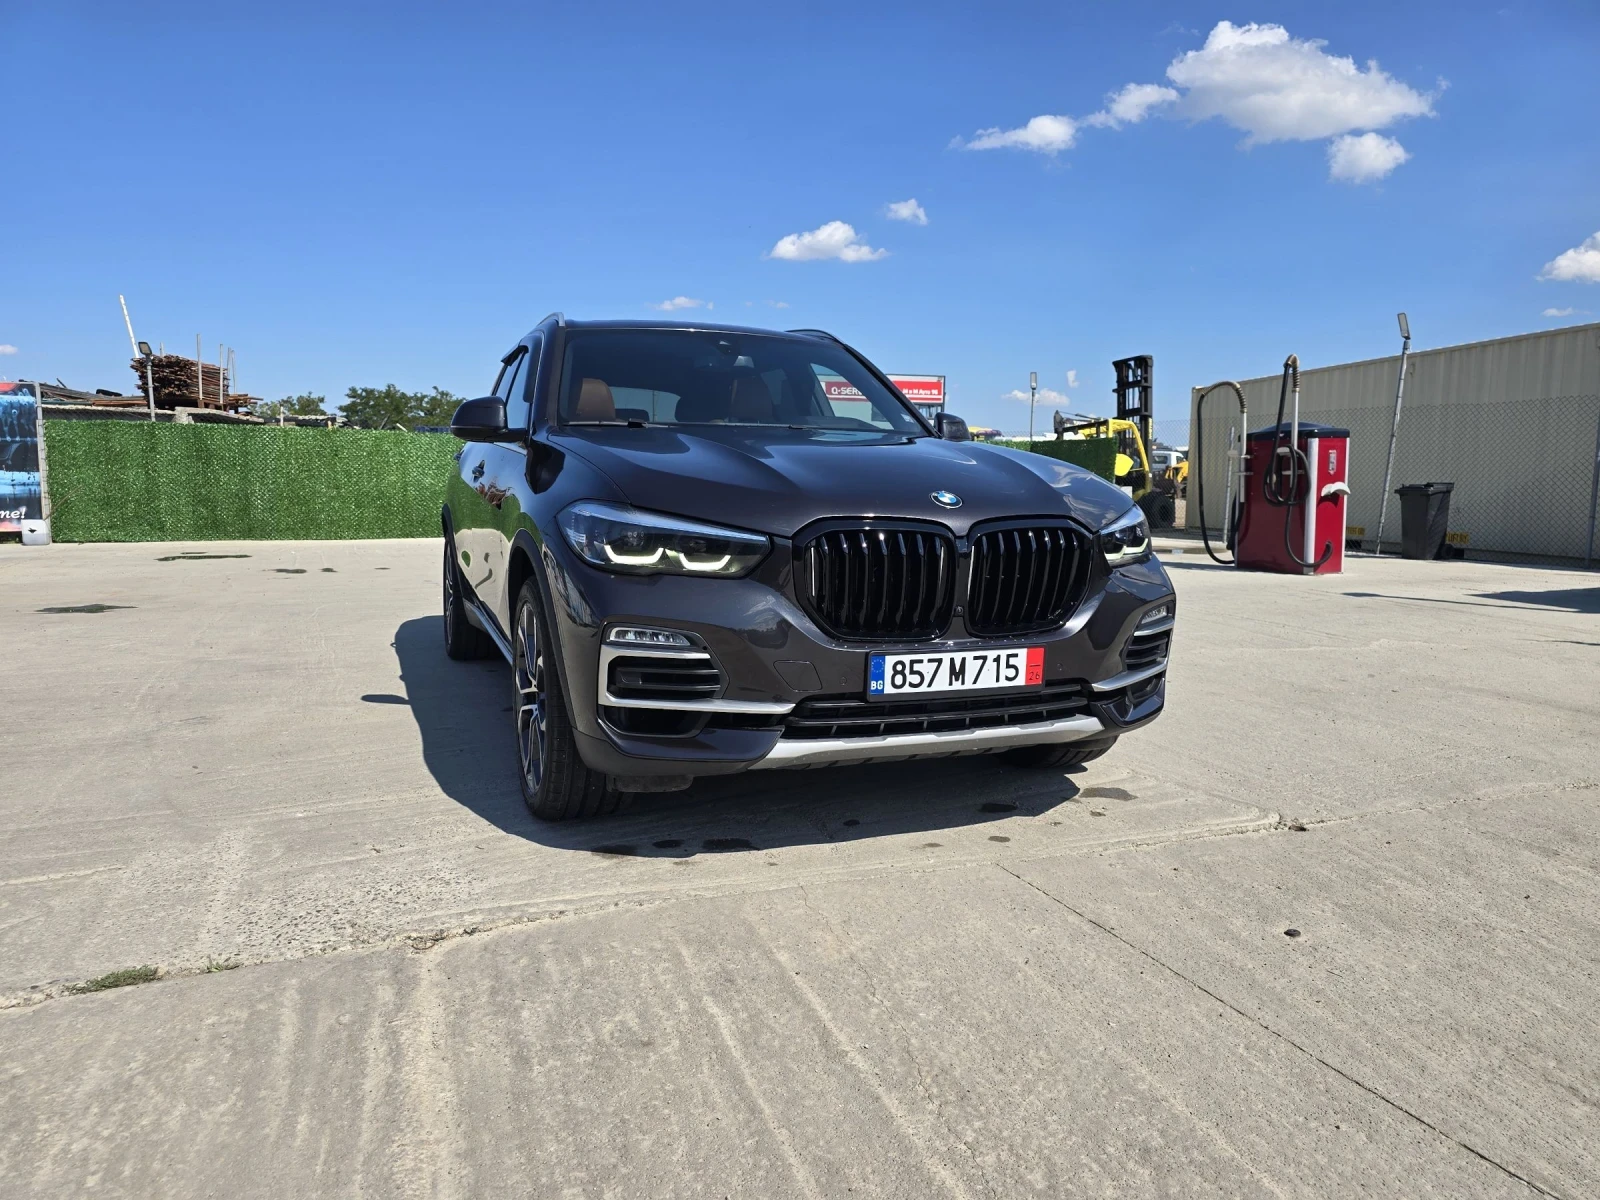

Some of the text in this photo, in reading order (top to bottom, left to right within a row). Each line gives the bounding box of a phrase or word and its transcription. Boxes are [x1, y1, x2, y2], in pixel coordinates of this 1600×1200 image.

[890, 652, 1019, 689] 857 M 715
[1028, 671, 1040, 681] 26
[871, 680, 883, 690] BG
